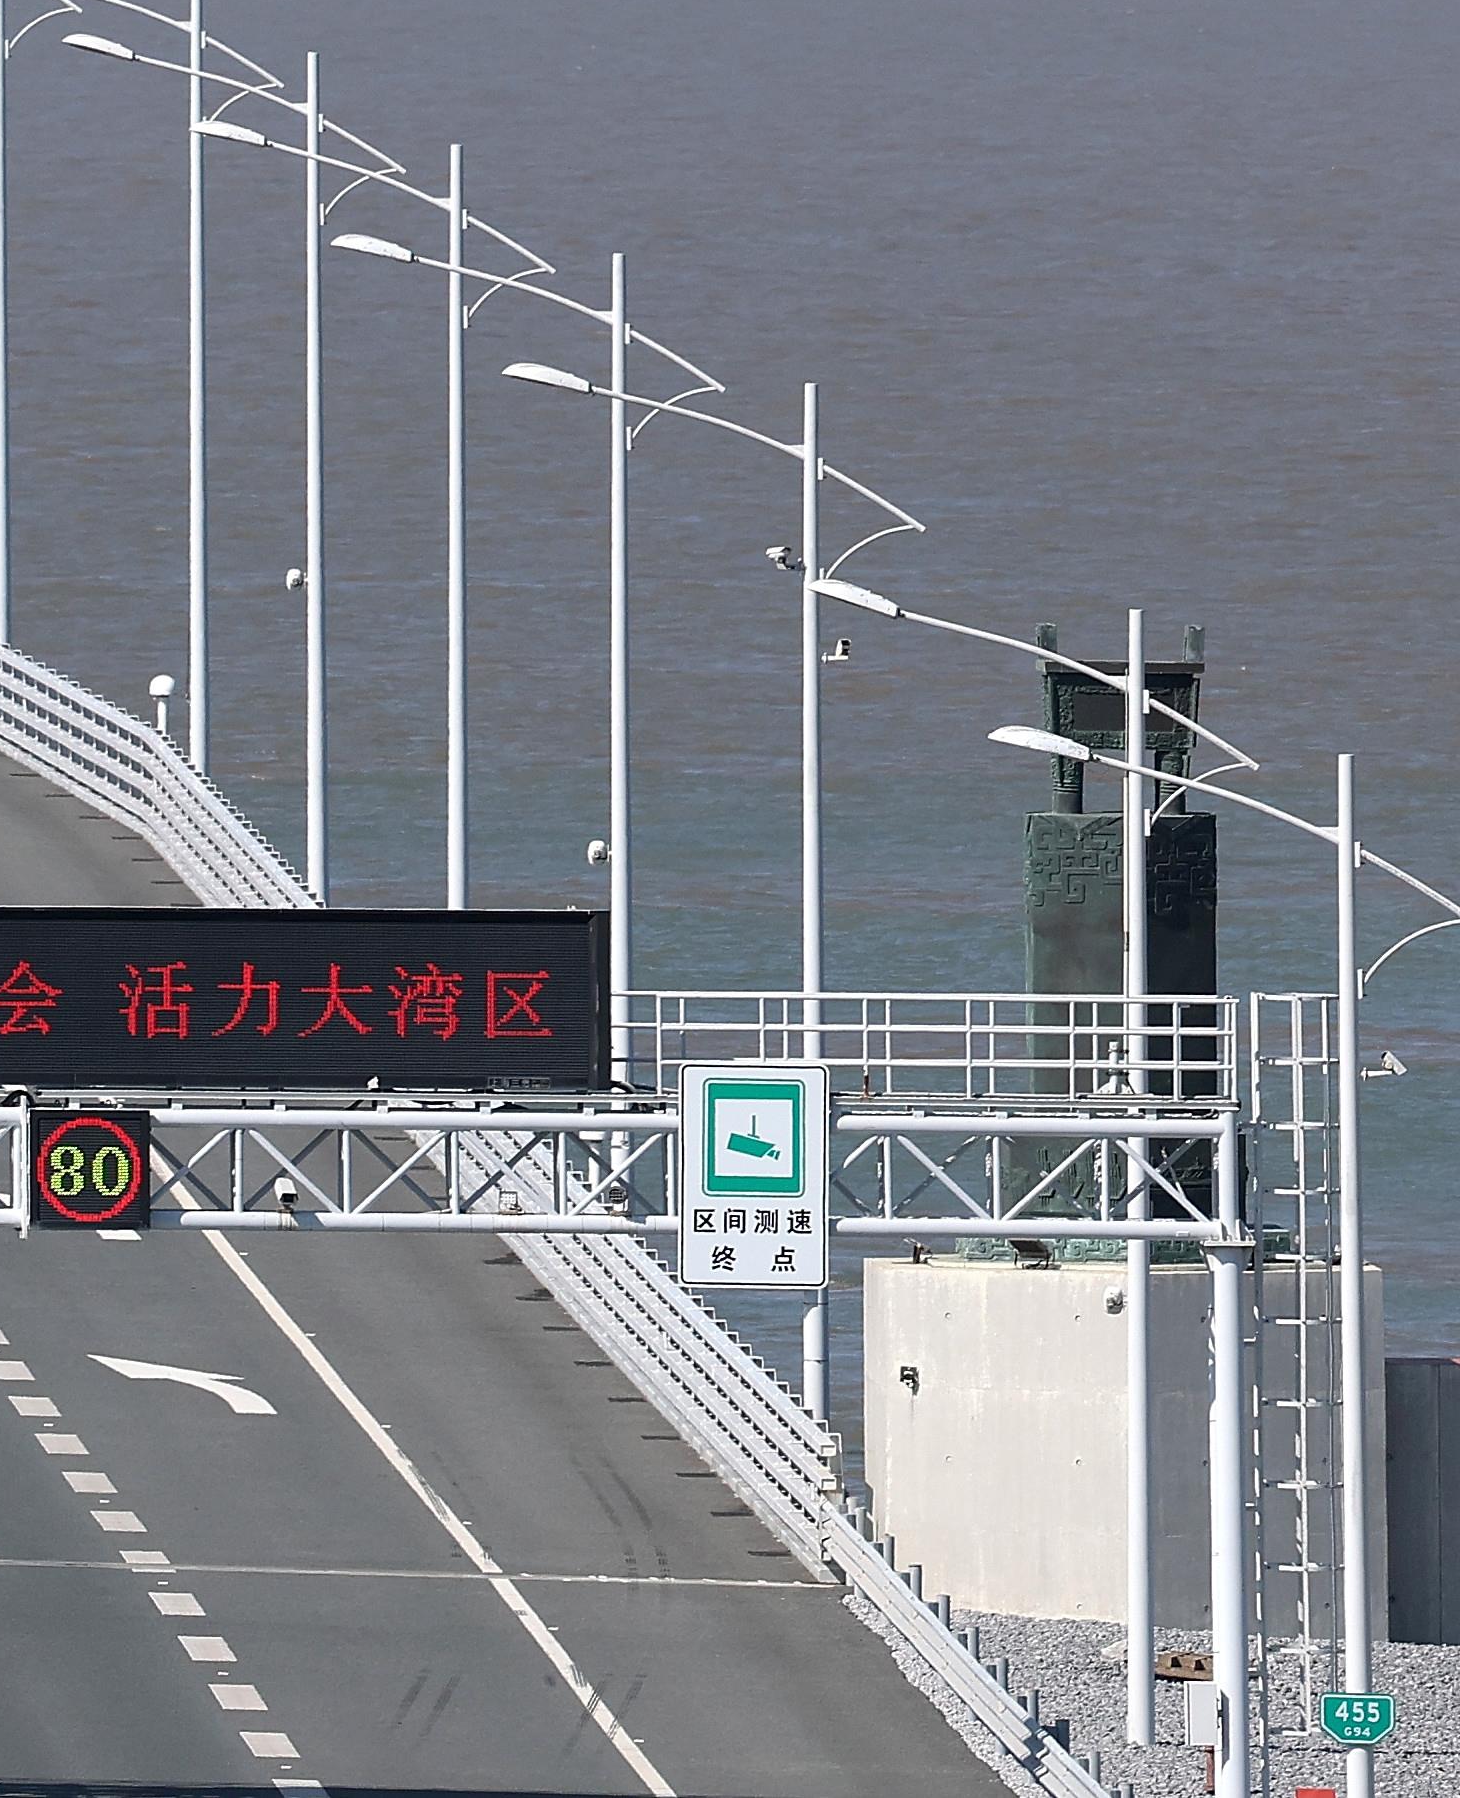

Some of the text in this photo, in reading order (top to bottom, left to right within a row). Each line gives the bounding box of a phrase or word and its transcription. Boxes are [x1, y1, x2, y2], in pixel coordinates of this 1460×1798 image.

[119, 961, 552, 1041] 活力大湾区
[51, 1147, 128, 1196] 80
[693, 1207, 813, 1235] 区间测速
[711, 1245, 796, 1272] 终点
[1335, 1701, 1380, 1723] 455
[1344, 1727, 1371, 1737] G94
